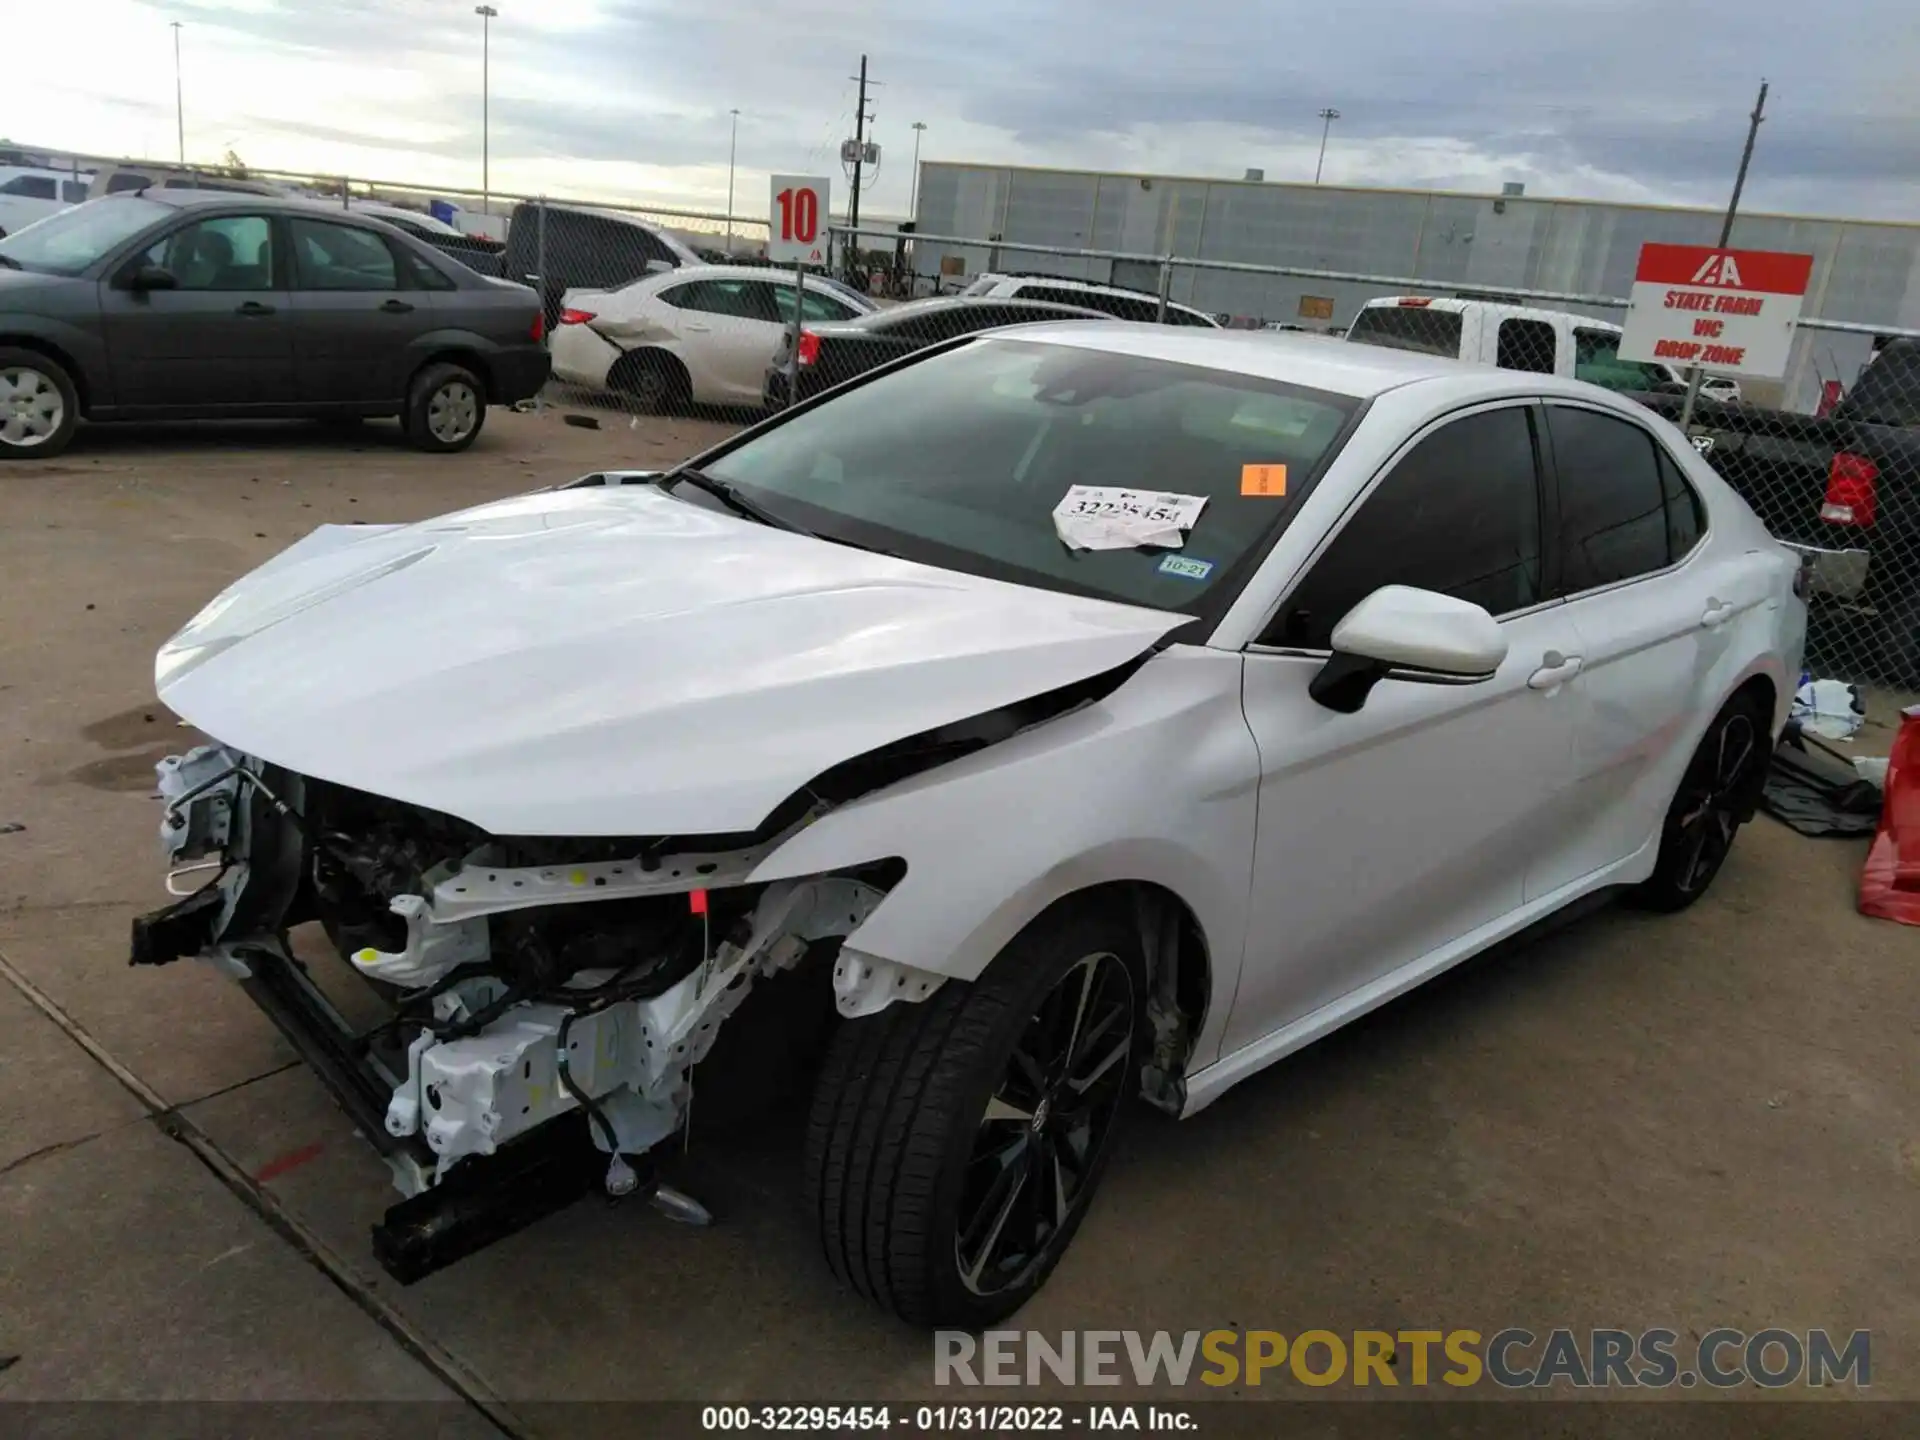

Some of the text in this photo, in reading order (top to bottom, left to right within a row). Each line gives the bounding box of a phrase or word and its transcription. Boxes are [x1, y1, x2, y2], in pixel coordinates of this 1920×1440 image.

[776, 187, 817, 244] 10
[1663, 289, 1765, 317] STATE FARM
[1692, 318, 1725, 339] VIC
[1653, 339, 1747, 366] DROP ZONE
[1165, 559, 1206, 576] 10-21
